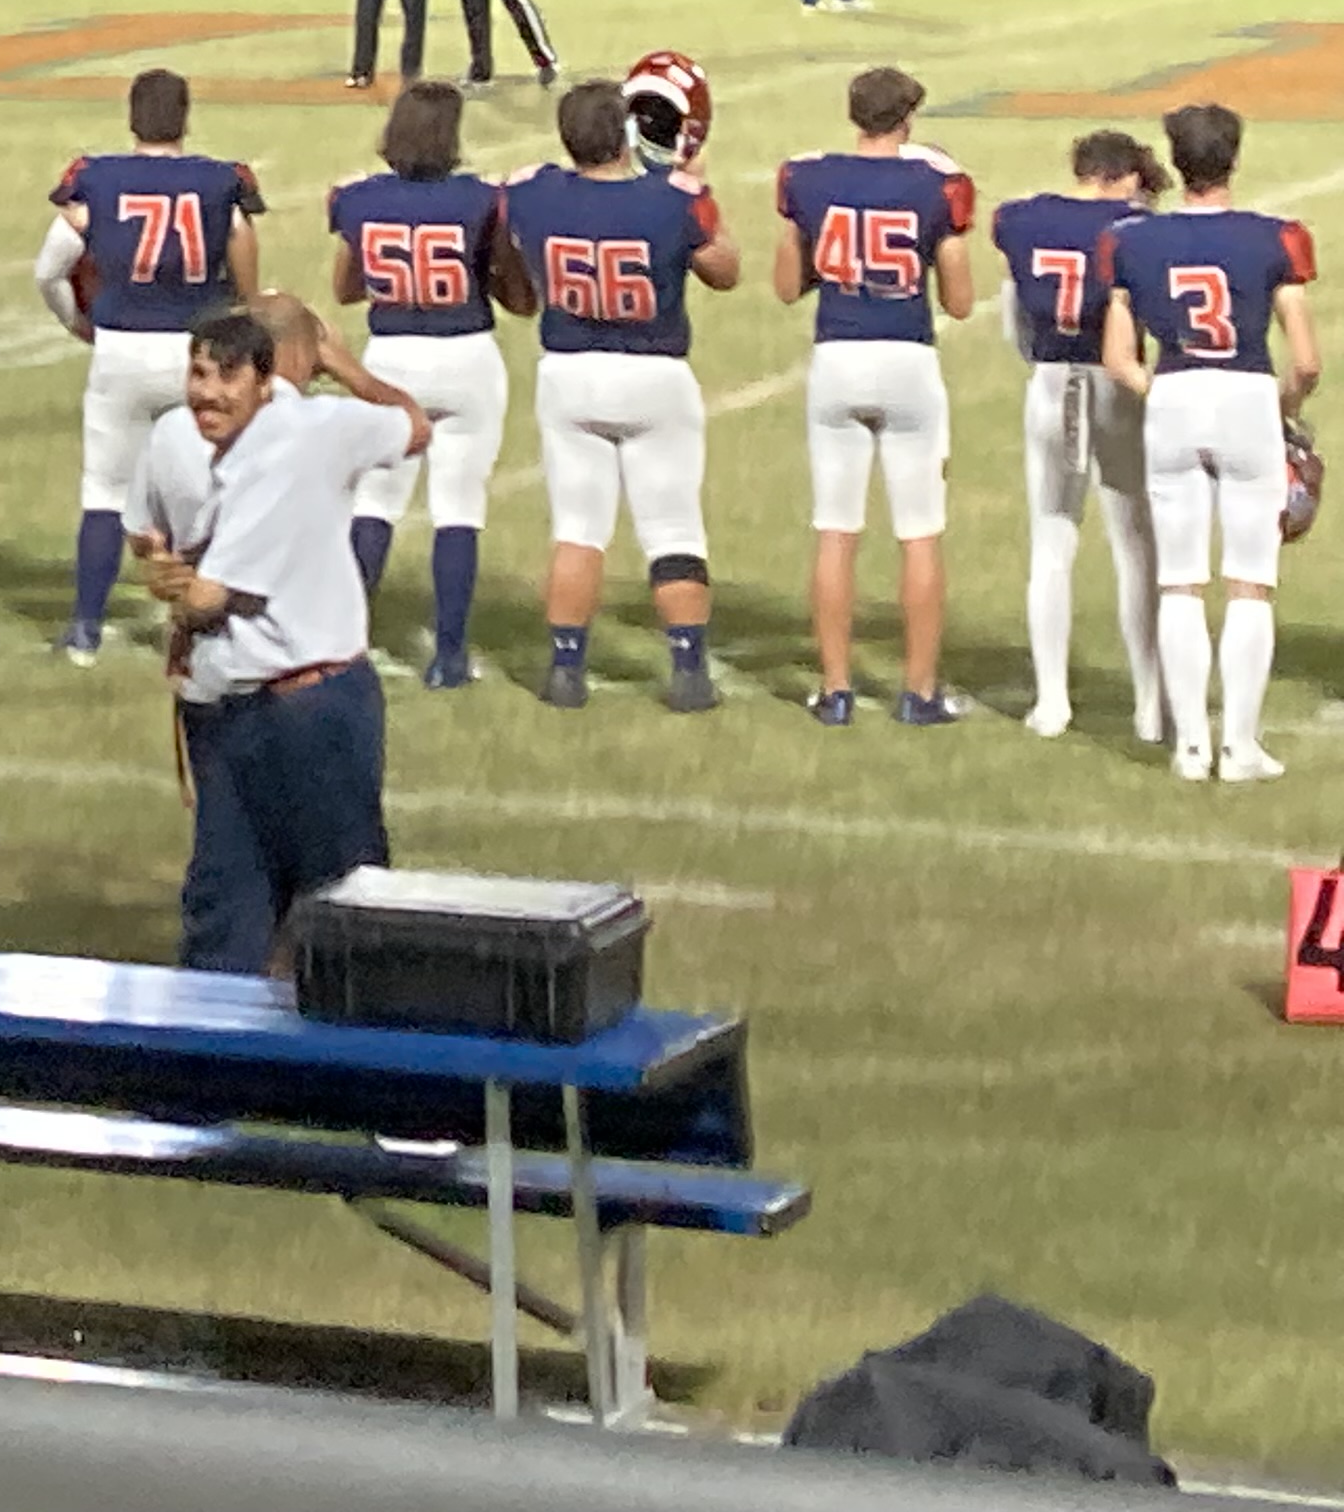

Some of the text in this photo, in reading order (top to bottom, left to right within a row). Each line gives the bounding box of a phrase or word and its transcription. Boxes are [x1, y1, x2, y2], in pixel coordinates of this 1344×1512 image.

[118, 194, 204, 283] 71
[362, 223, 469, 307] 56
[544, 236, 657, 321] 66
[815, 206, 921, 299] 45
[1032, 249, 1085, 335] 7
[1169, 267, 1238, 358] 3
